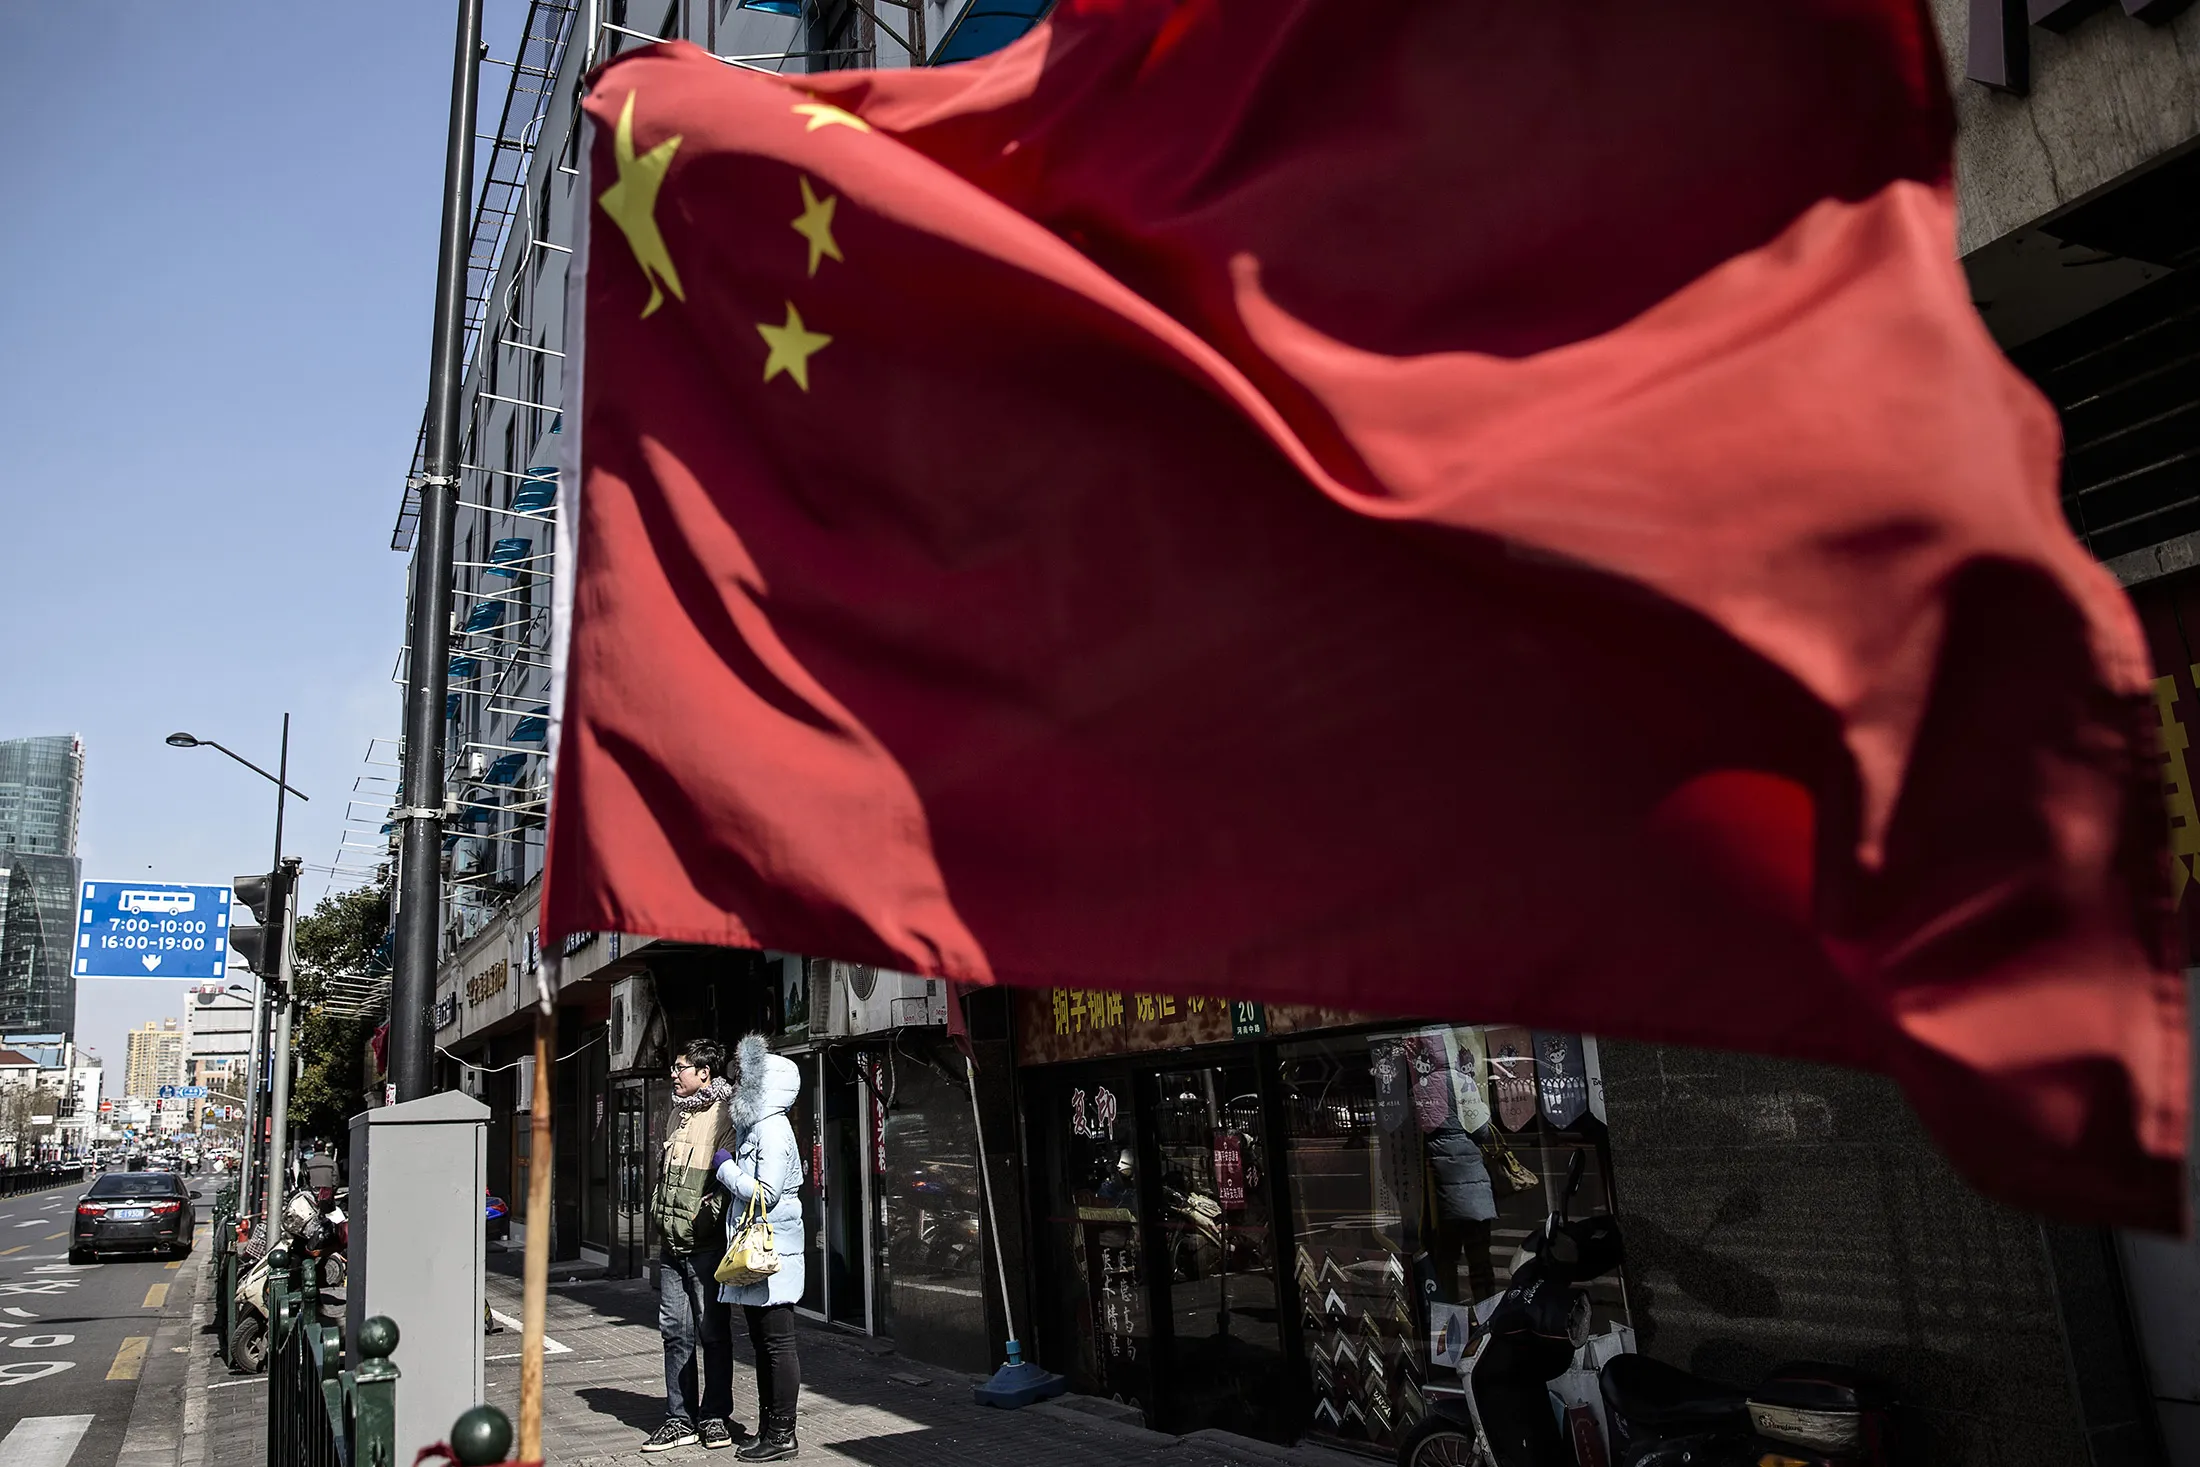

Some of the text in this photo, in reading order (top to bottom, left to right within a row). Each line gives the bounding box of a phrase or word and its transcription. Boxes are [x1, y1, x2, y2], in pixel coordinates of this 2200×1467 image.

[109, 918, 207, 934] 7:00-10:00
[101, 935, 205, 951] 16:00-19:00
[1238, 1000, 1255, 1023] 20
[1071, 1085, 1118, 1141] 复印
